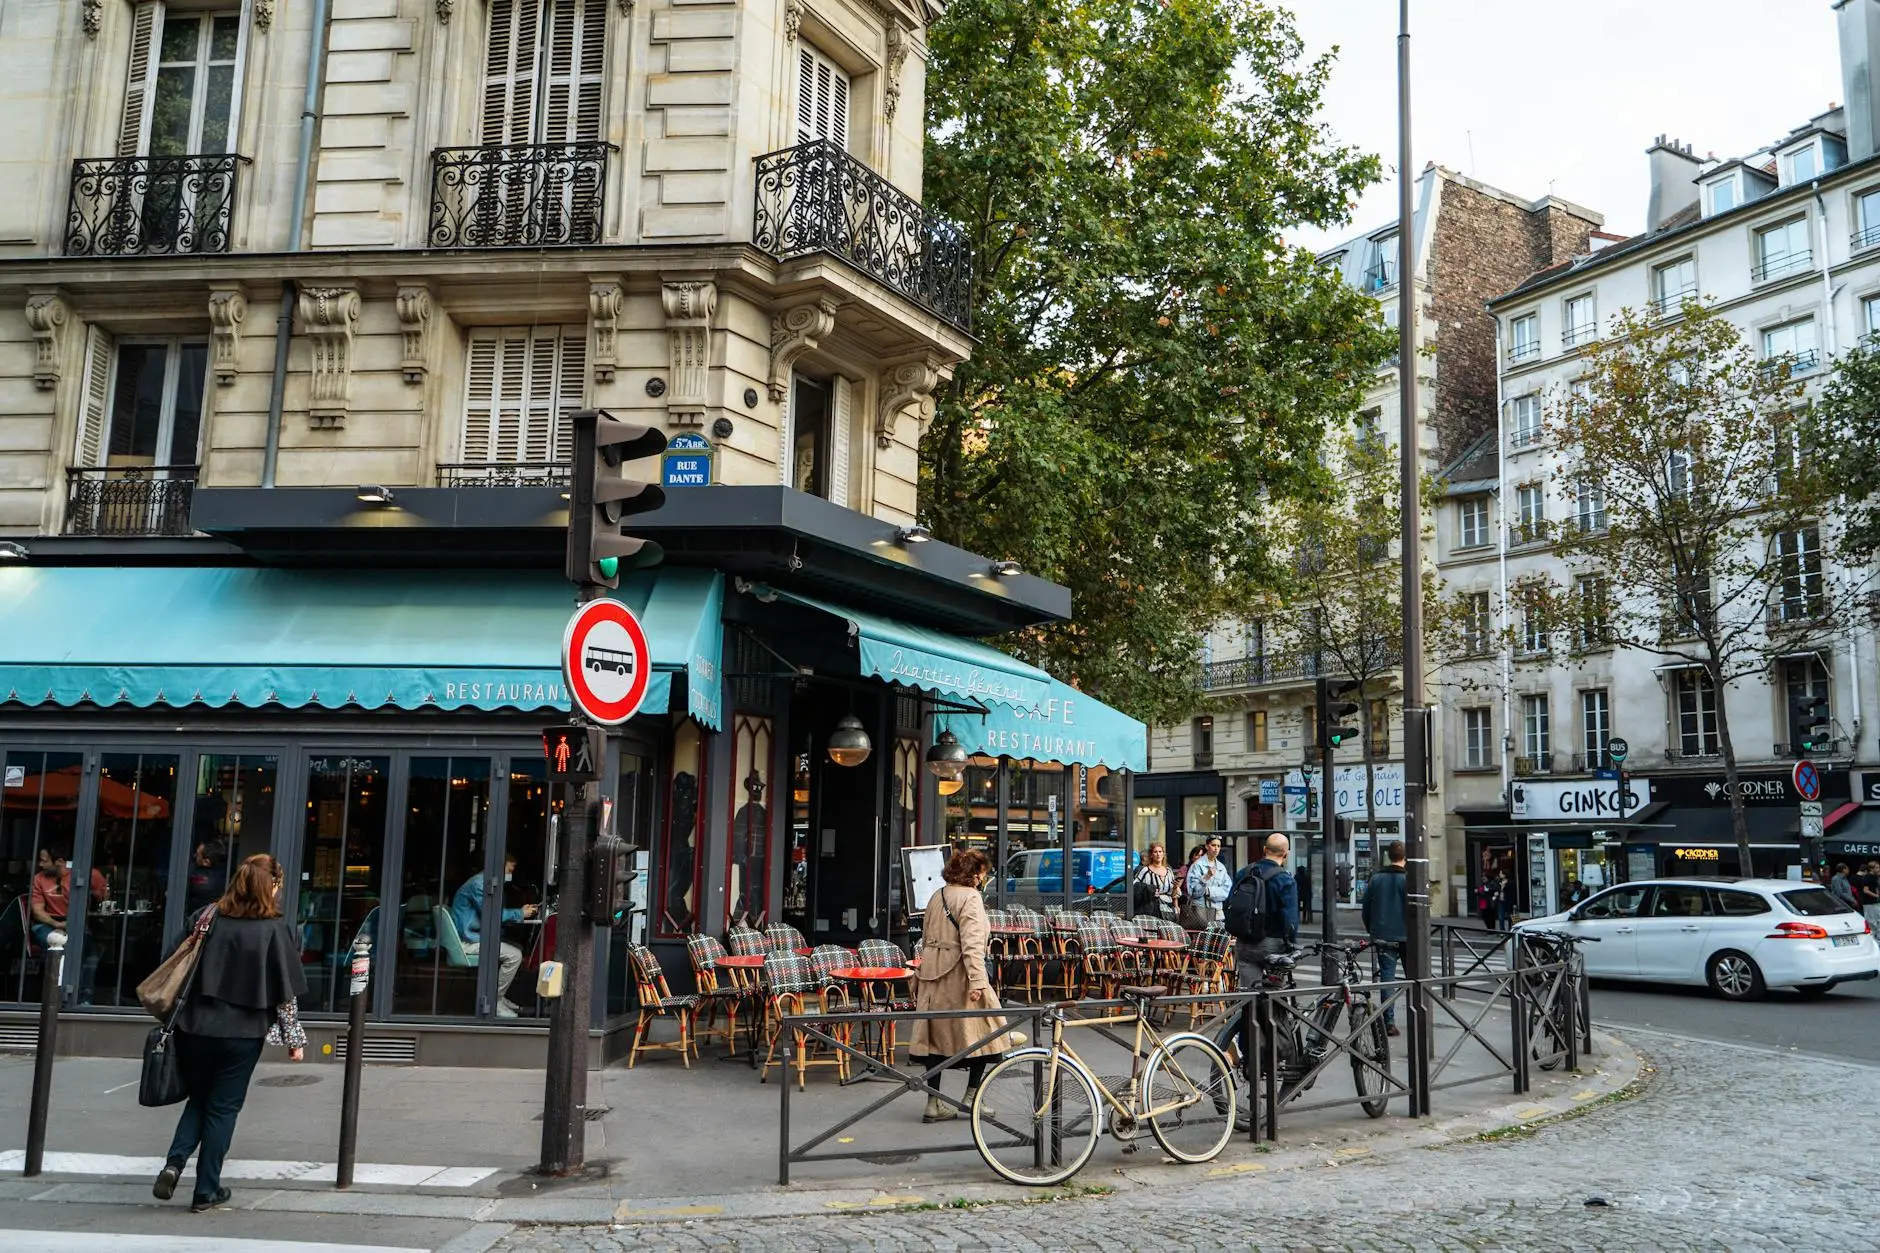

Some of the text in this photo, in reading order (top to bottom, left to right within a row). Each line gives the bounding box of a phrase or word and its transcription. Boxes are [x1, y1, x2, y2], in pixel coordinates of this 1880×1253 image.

[676, 461, 698, 471] RUE
[669, 474, 704, 484] DANTE
[890, 649, 966, 689] Quartier
[988, 729, 1096, 756] RESTAURANT
[1609, 743, 1626, 752] BUS
[1722, 780, 1785, 795] COONER
[1356, 787, 1402, 807] EOLE
[1685, 848, 1719, 858] CROONER
[1844, 844, 1868, 854] CAFE
